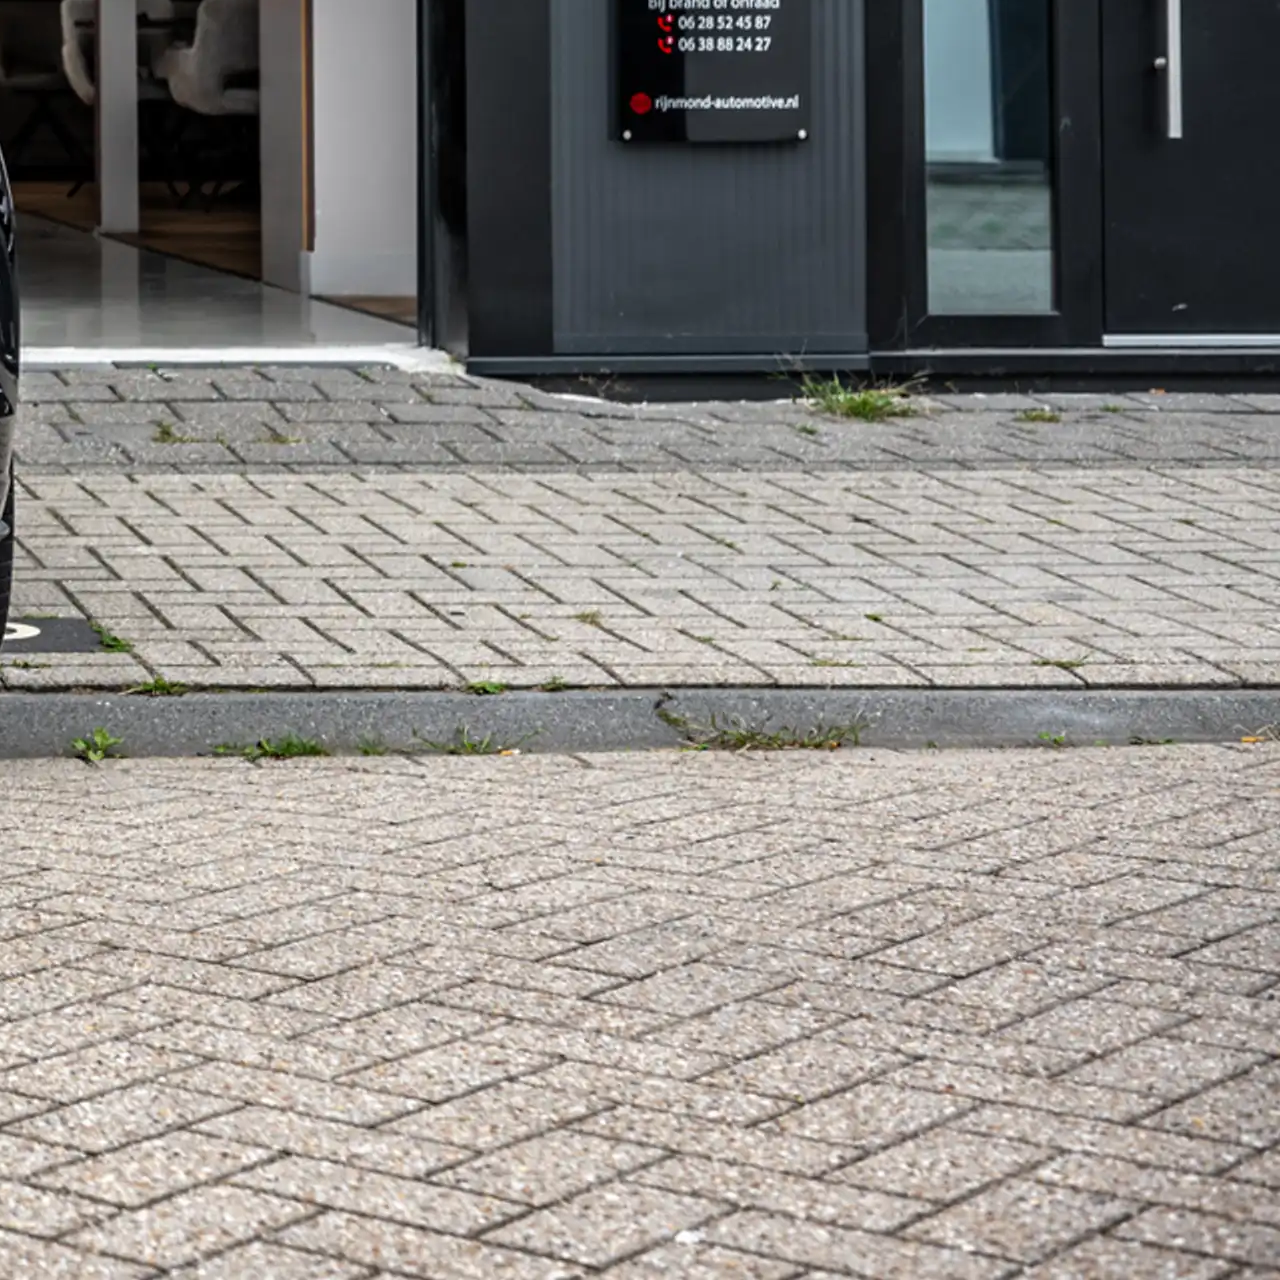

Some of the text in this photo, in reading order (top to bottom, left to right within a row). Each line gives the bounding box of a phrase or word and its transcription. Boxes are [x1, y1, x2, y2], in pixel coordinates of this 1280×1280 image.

[678, 15, 772, 30] 06 28 52 45 87
[678, 36, 695, 52] 06
[735, 36, 753, 52] 24
[754, 36, 772, 52] 27
[655, 94, 800, 112] rijnmond-automotive.nl
